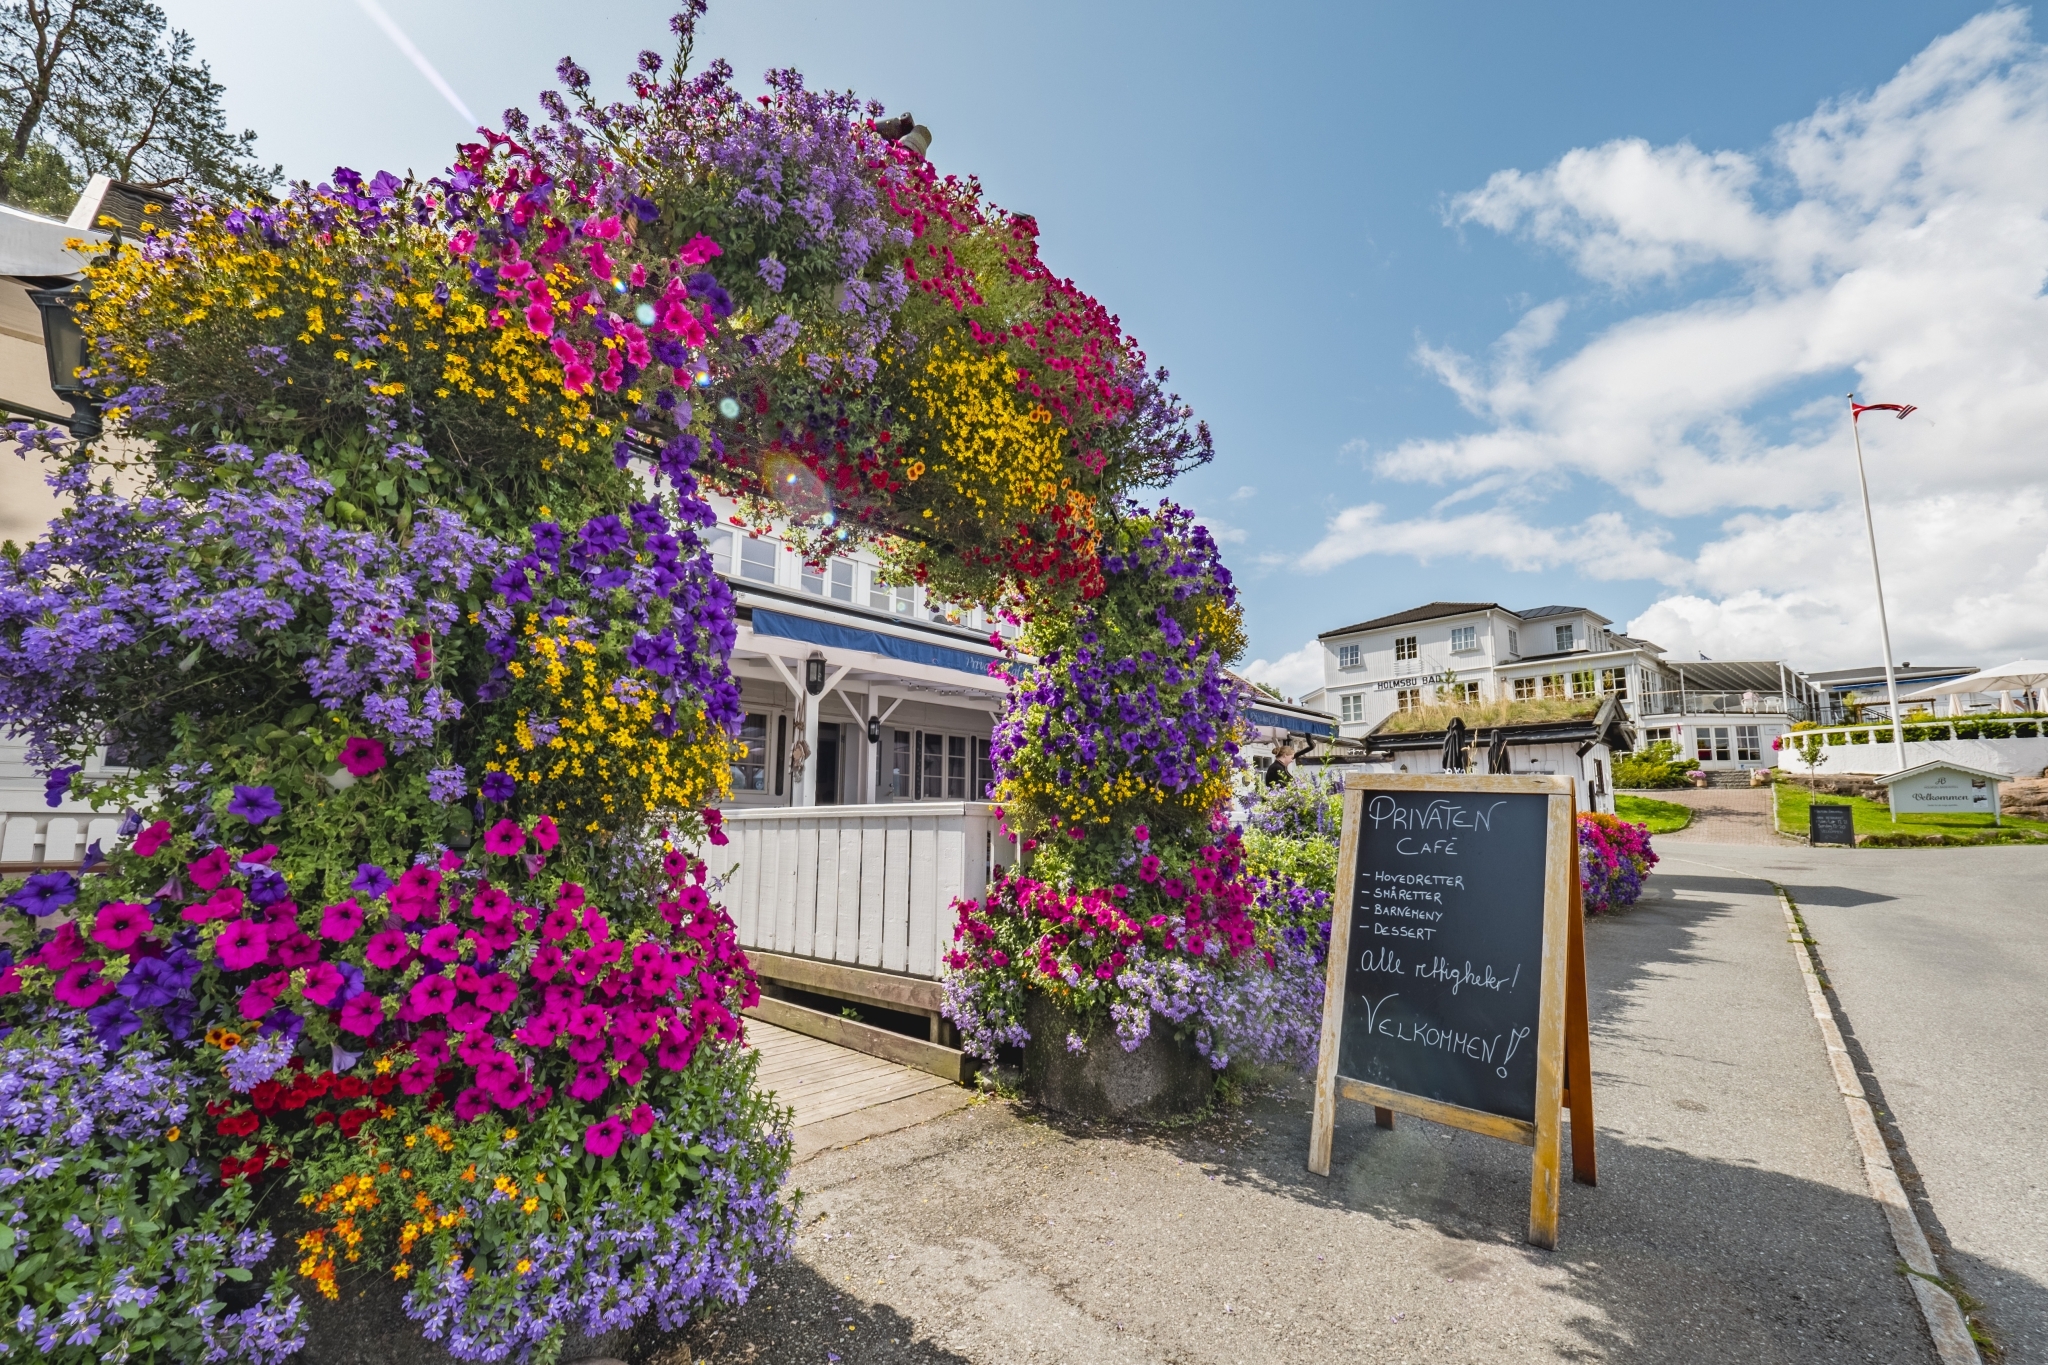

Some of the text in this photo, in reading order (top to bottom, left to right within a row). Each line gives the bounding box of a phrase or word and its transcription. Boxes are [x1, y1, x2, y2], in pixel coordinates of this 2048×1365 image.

[1377, 677, 1417, 690] HOLMSBU
[1912, 793, 1969, 801] Velkommen
[1369, 795, 1507, 832] PRIVATEN
[1396, 837, 1458, 855] CAFÉ
[1374, 870, 1465, 891] HOVEDRETTER
[1373, 885, 1443, 904] SMÅRETTER
[1374, 903, 1443, 922] BARNEMENY
[1374, 922, 1437, 941] DESSERT
[1361, 992, 1531, 1079] VELKOMMEN!
